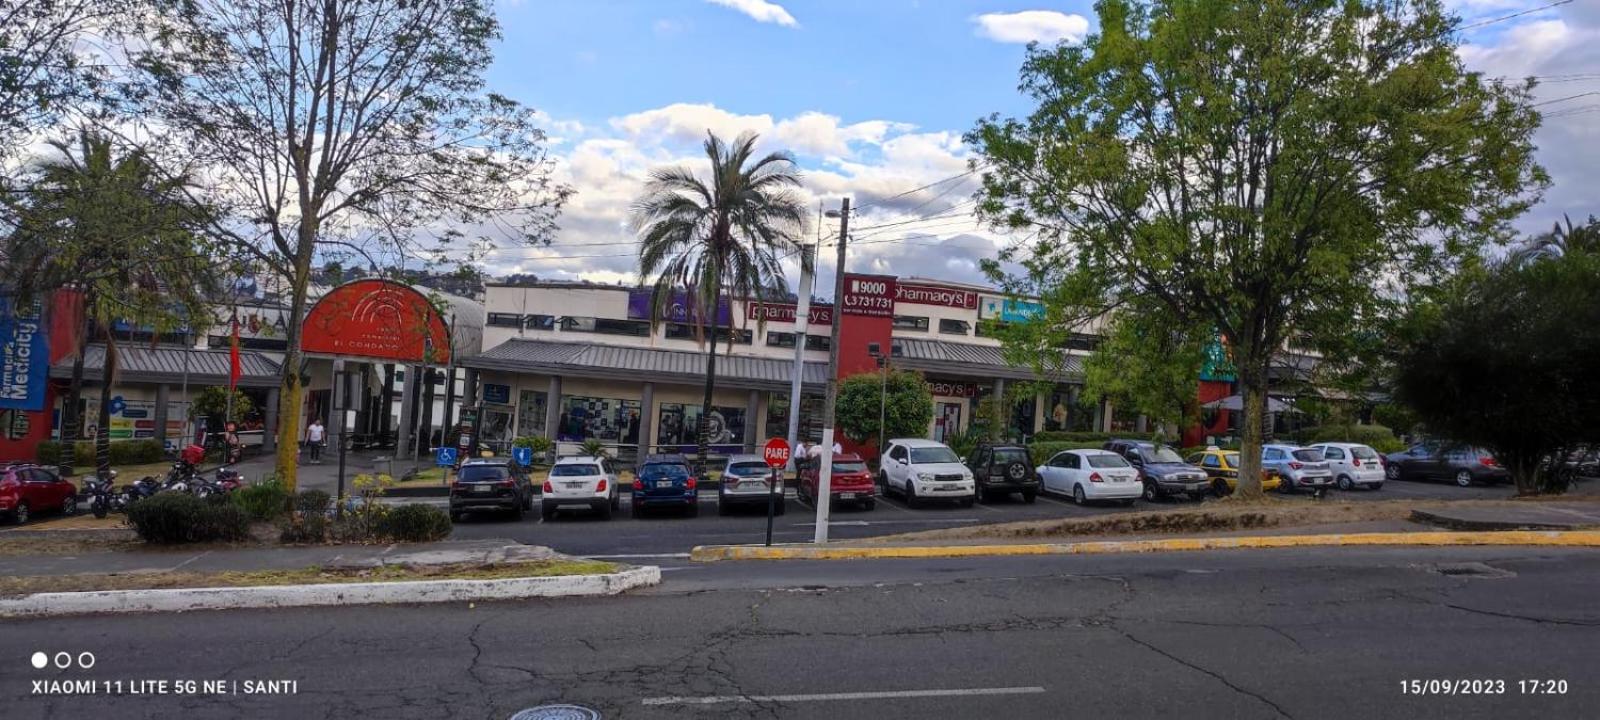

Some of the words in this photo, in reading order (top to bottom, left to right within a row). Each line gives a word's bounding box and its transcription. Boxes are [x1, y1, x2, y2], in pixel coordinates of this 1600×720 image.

[861, 281, 886, 295] 9000
[11, 323, 37, 400] Medicity
[765, 447, 789, 459] PARE
